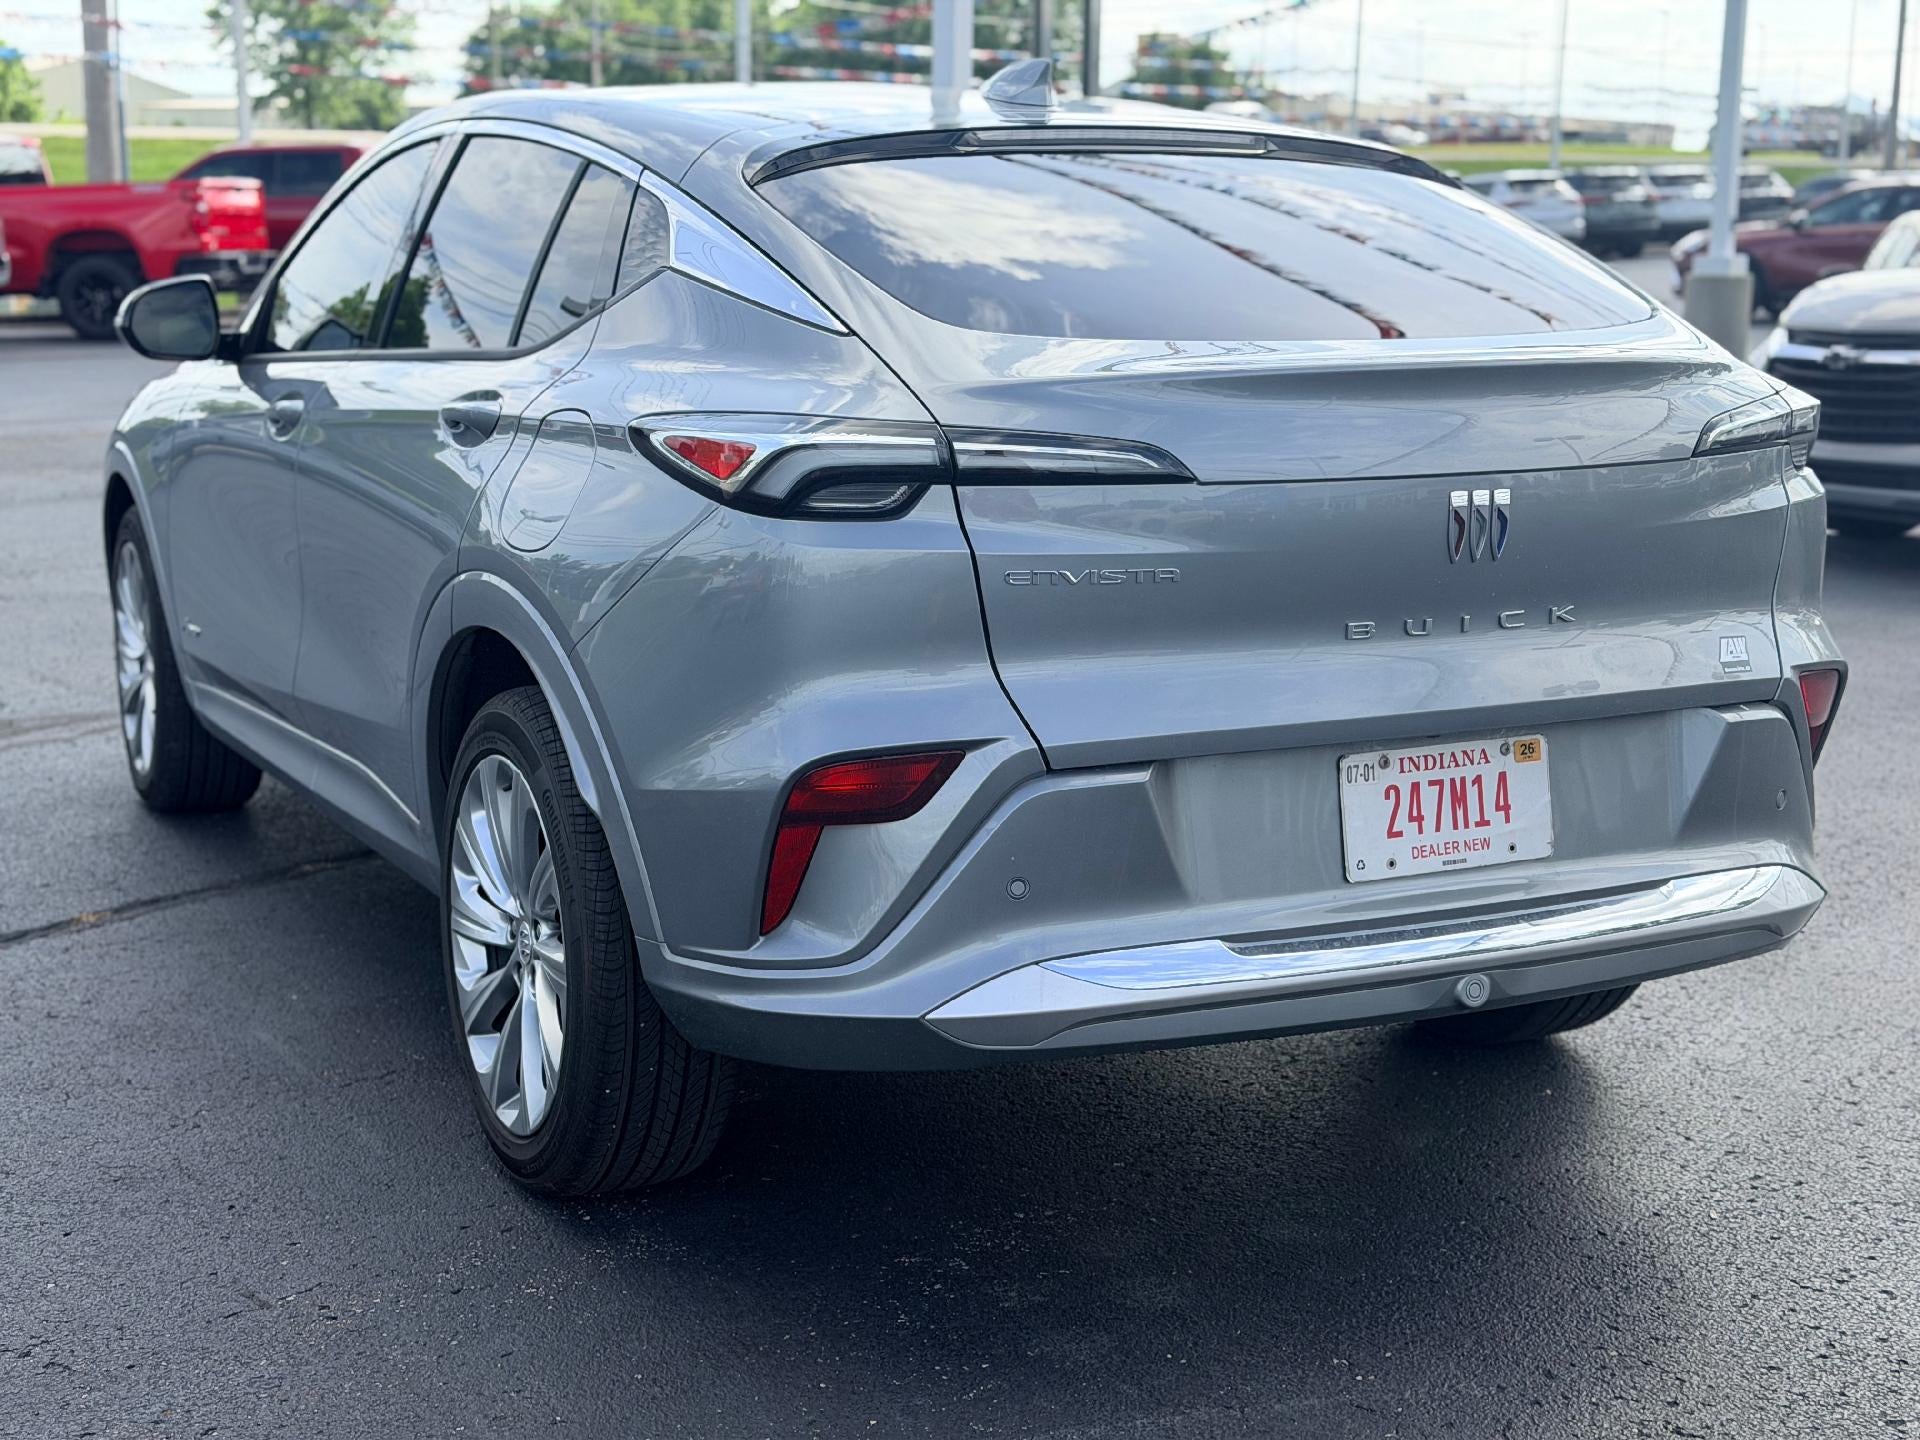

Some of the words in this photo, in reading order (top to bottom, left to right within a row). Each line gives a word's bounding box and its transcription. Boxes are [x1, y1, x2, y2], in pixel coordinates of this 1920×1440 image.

[1004, 567, 1181, 586] ENVISTA
[1345, 604, 1576, 641] BUICK
[1398, 748, 1491, 774] INDIANA
[1520, 742, 1535, 756] 26
[1346, 763, 1376, 784] 07-01
[1384, 770, 1512, 840] 247M14
[1411, 840, 1461, 860] DEALER
[1463, 836, 1491, 853] NEW
